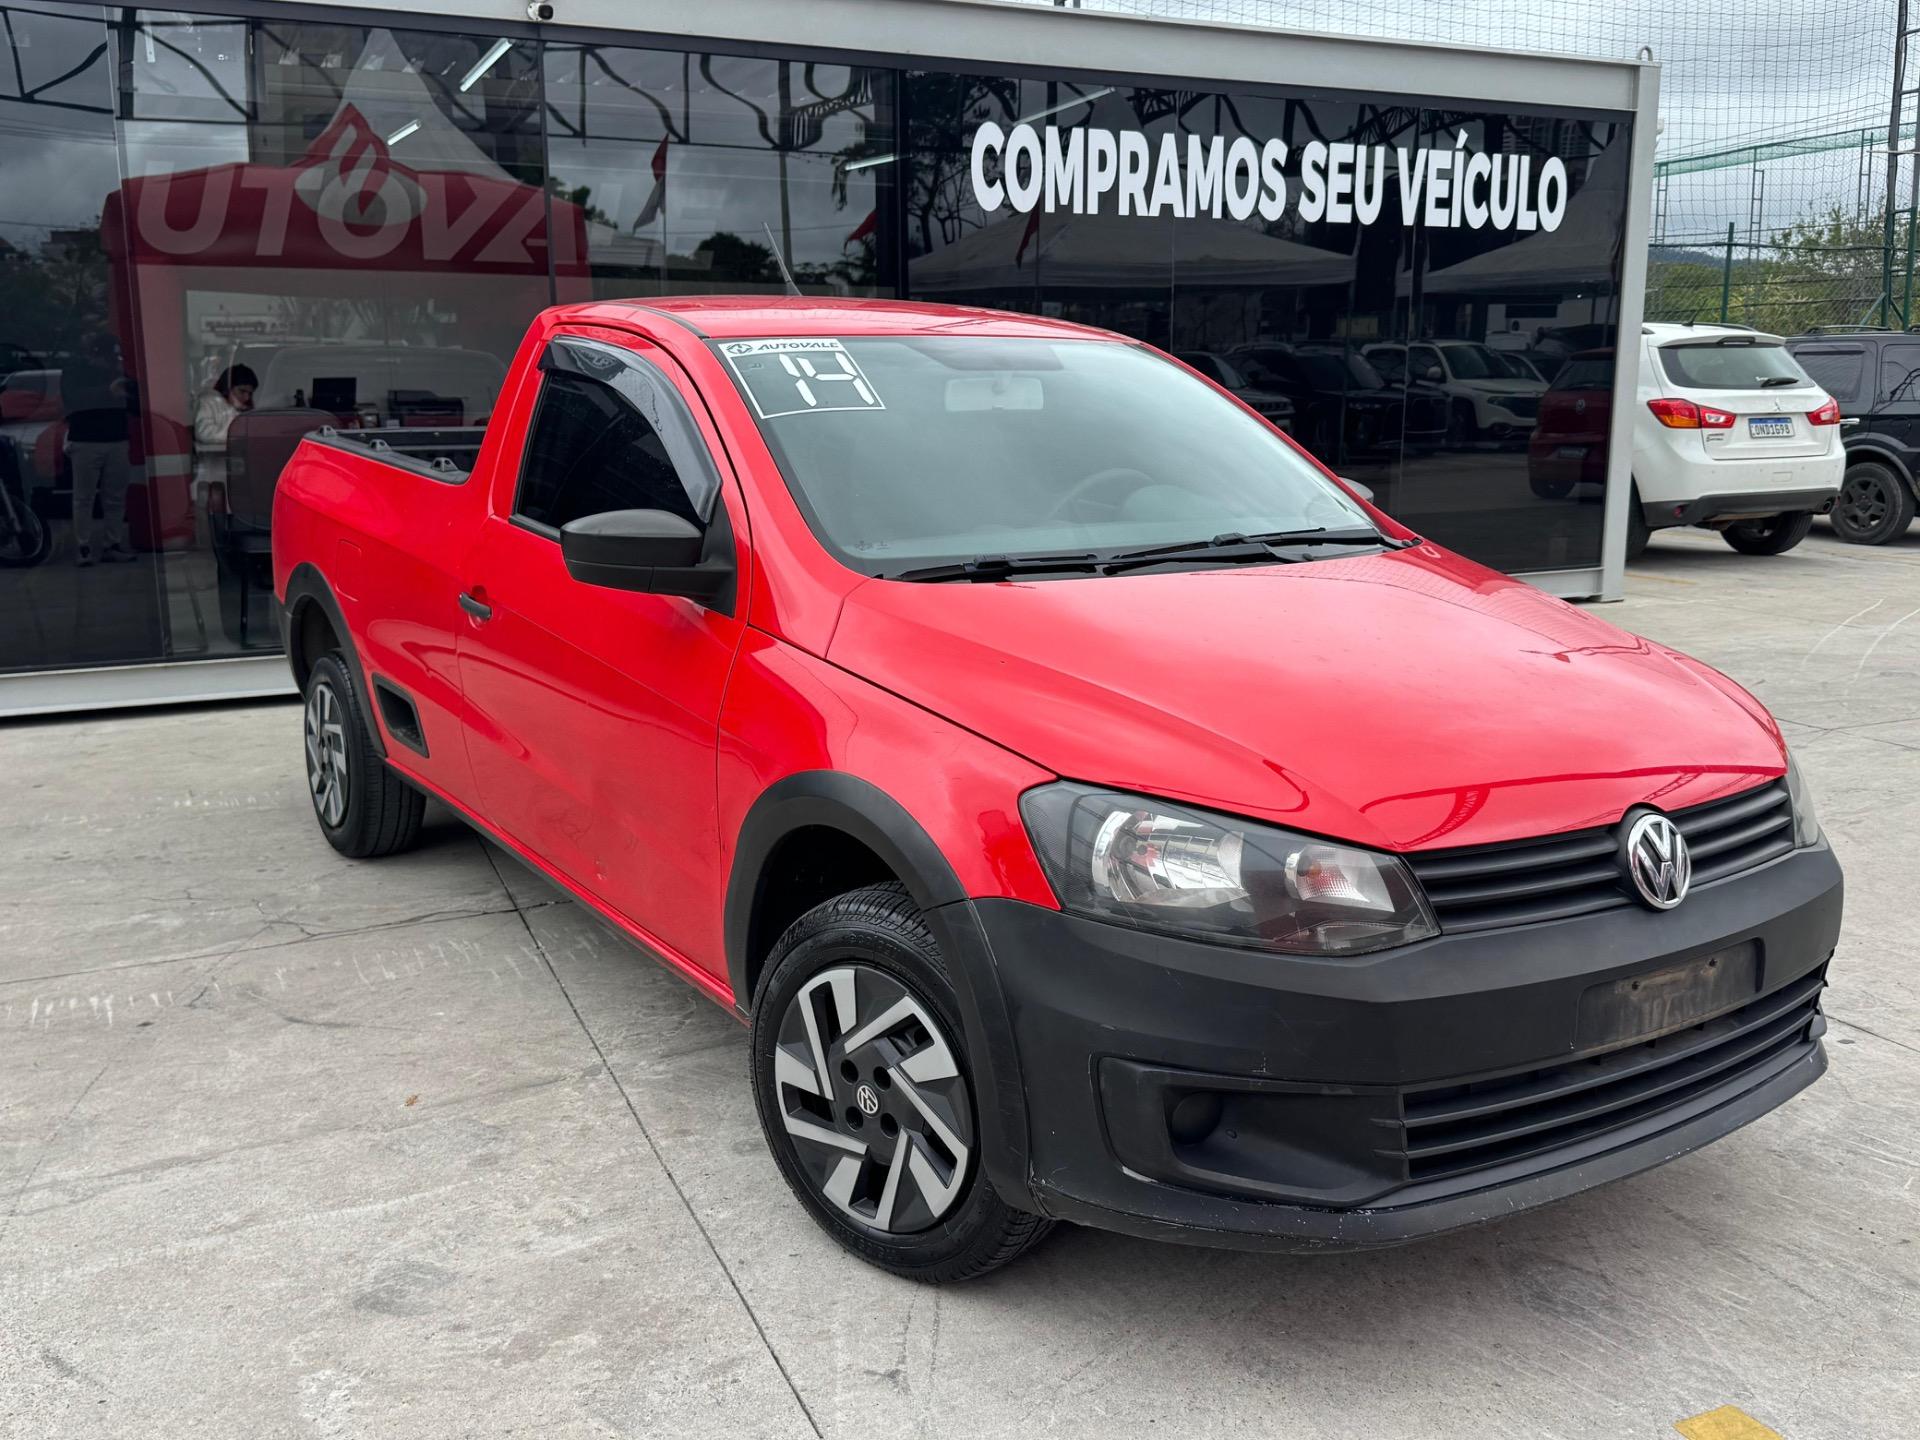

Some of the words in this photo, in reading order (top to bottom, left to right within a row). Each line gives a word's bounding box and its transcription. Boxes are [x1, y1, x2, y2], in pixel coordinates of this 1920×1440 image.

[970, 121, 1287, 222] COMPRAMOS
[1298, 140, 1387, 226] SEU
[1397, 129, 1568, 233] VEÍCULO
[757, 341, 840, 351] AUTOVALE
[778, 351, 875, 407] 14
